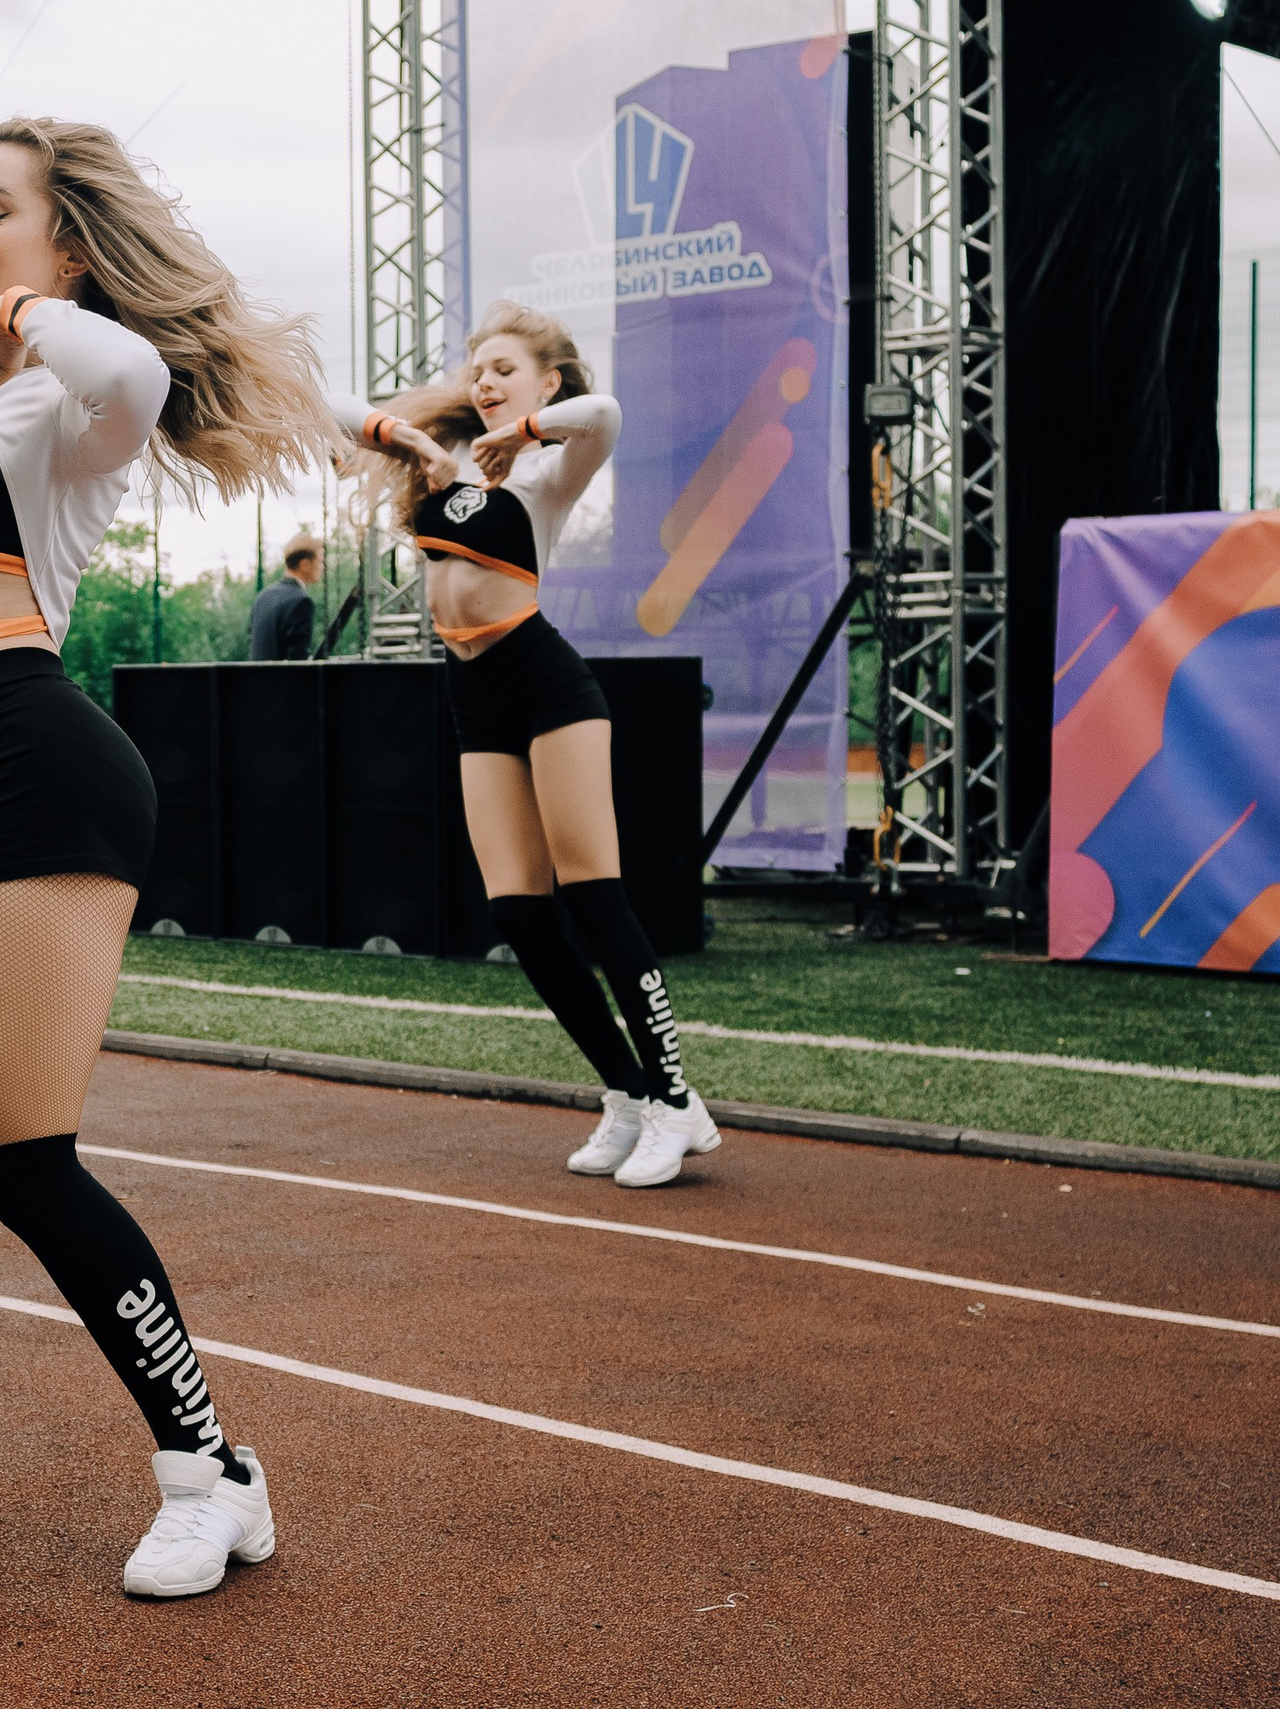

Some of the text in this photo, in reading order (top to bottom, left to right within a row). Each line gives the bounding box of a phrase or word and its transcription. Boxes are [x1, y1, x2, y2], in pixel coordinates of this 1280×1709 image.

[672, 260, 766, 290] ЗАВОД
[639, 968, 687, 1096] winline
[116, 1278, 223, 1456] winline
